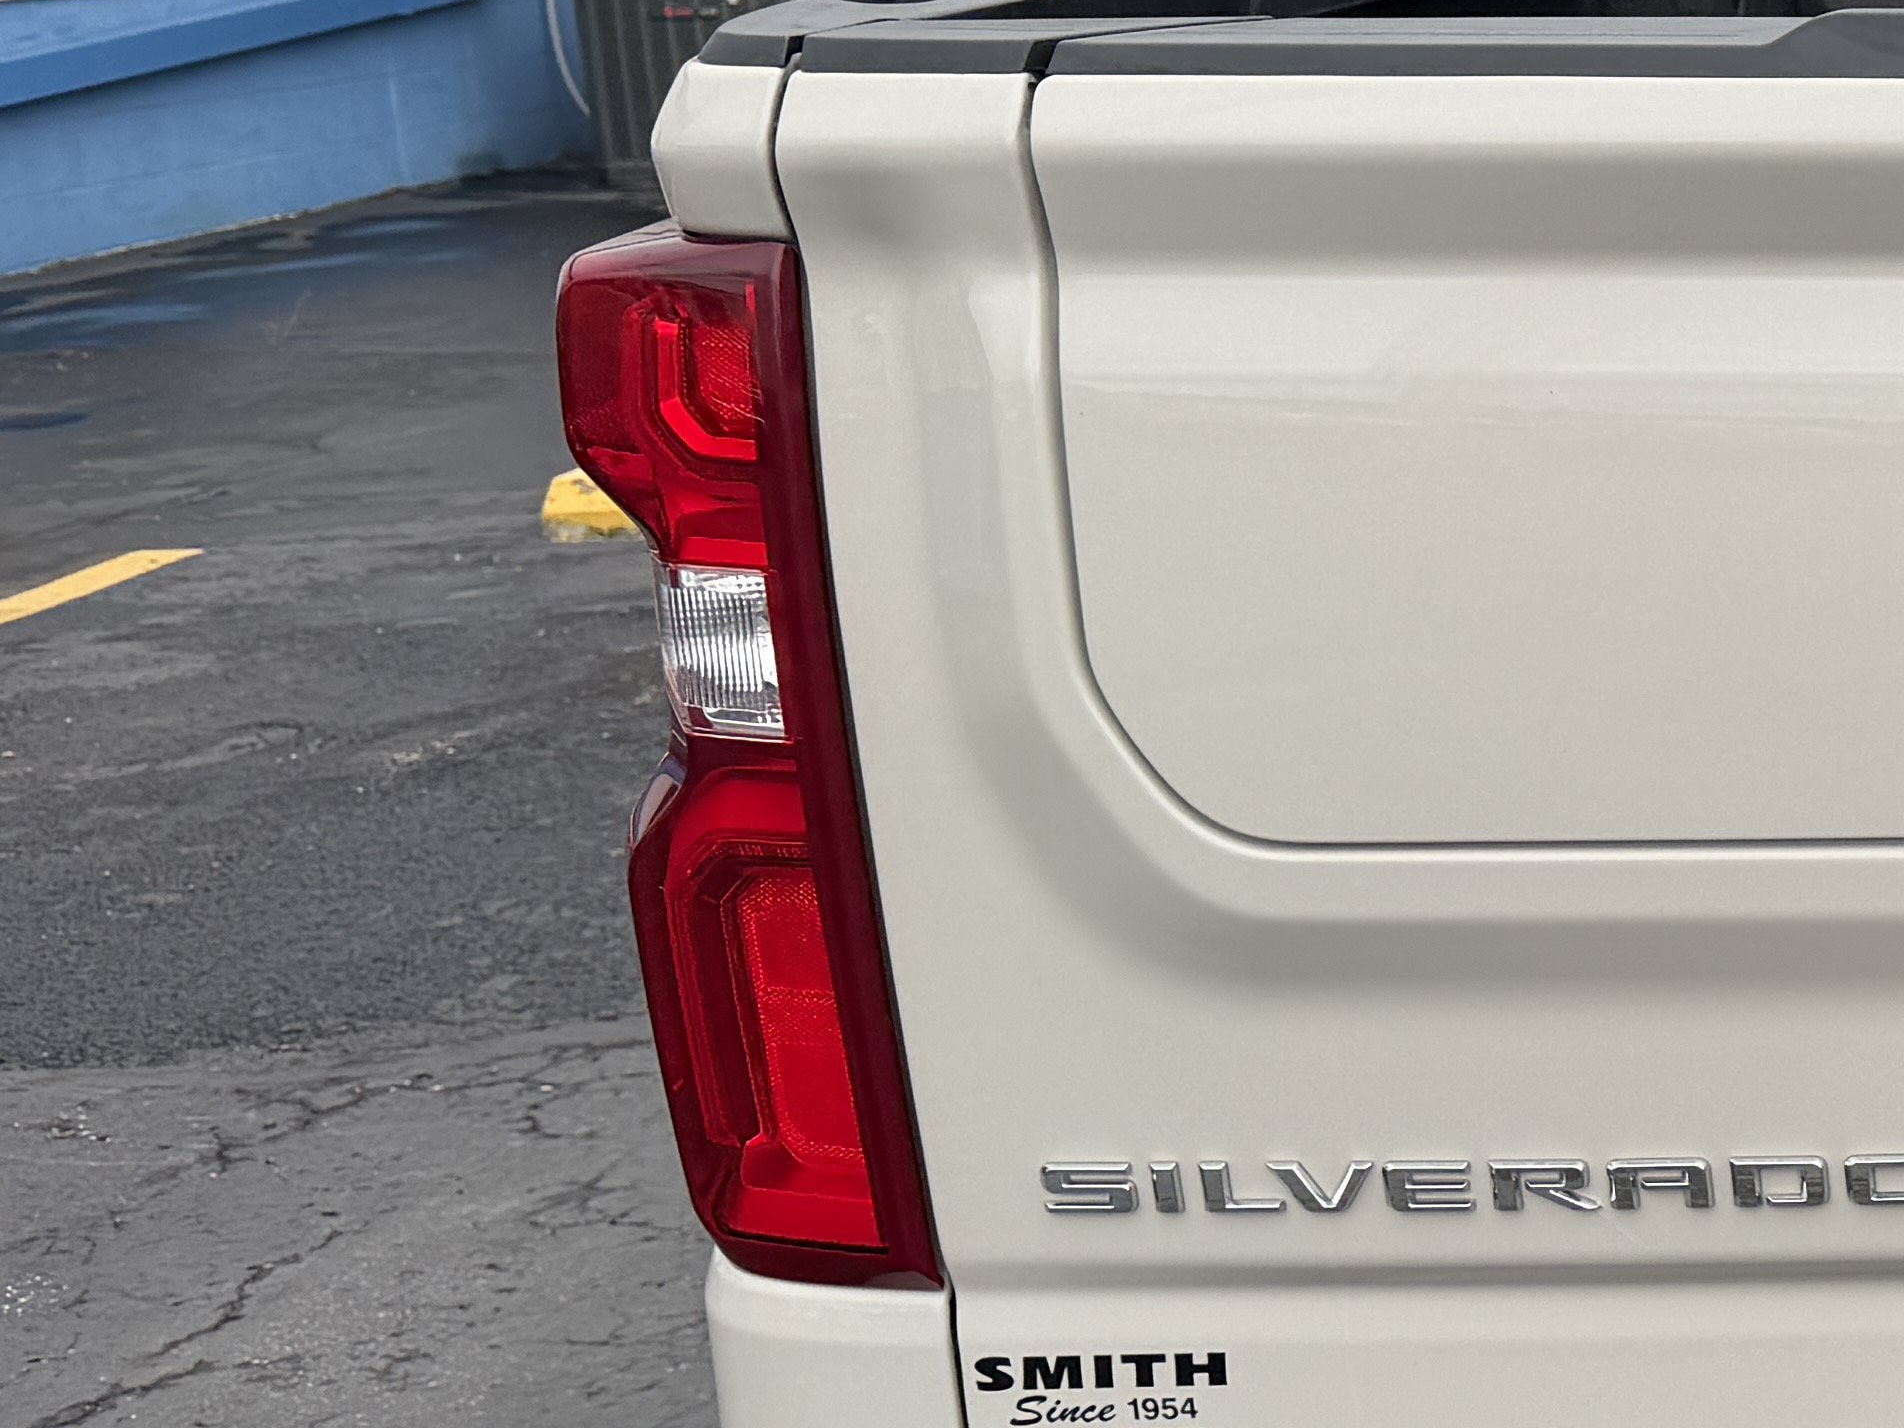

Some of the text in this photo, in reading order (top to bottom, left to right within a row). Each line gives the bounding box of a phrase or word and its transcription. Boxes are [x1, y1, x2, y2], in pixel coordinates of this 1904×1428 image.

[974, 1352, 1228, 1392] SMITH
[1009, 1395, 1199, 1426] Since 1954
